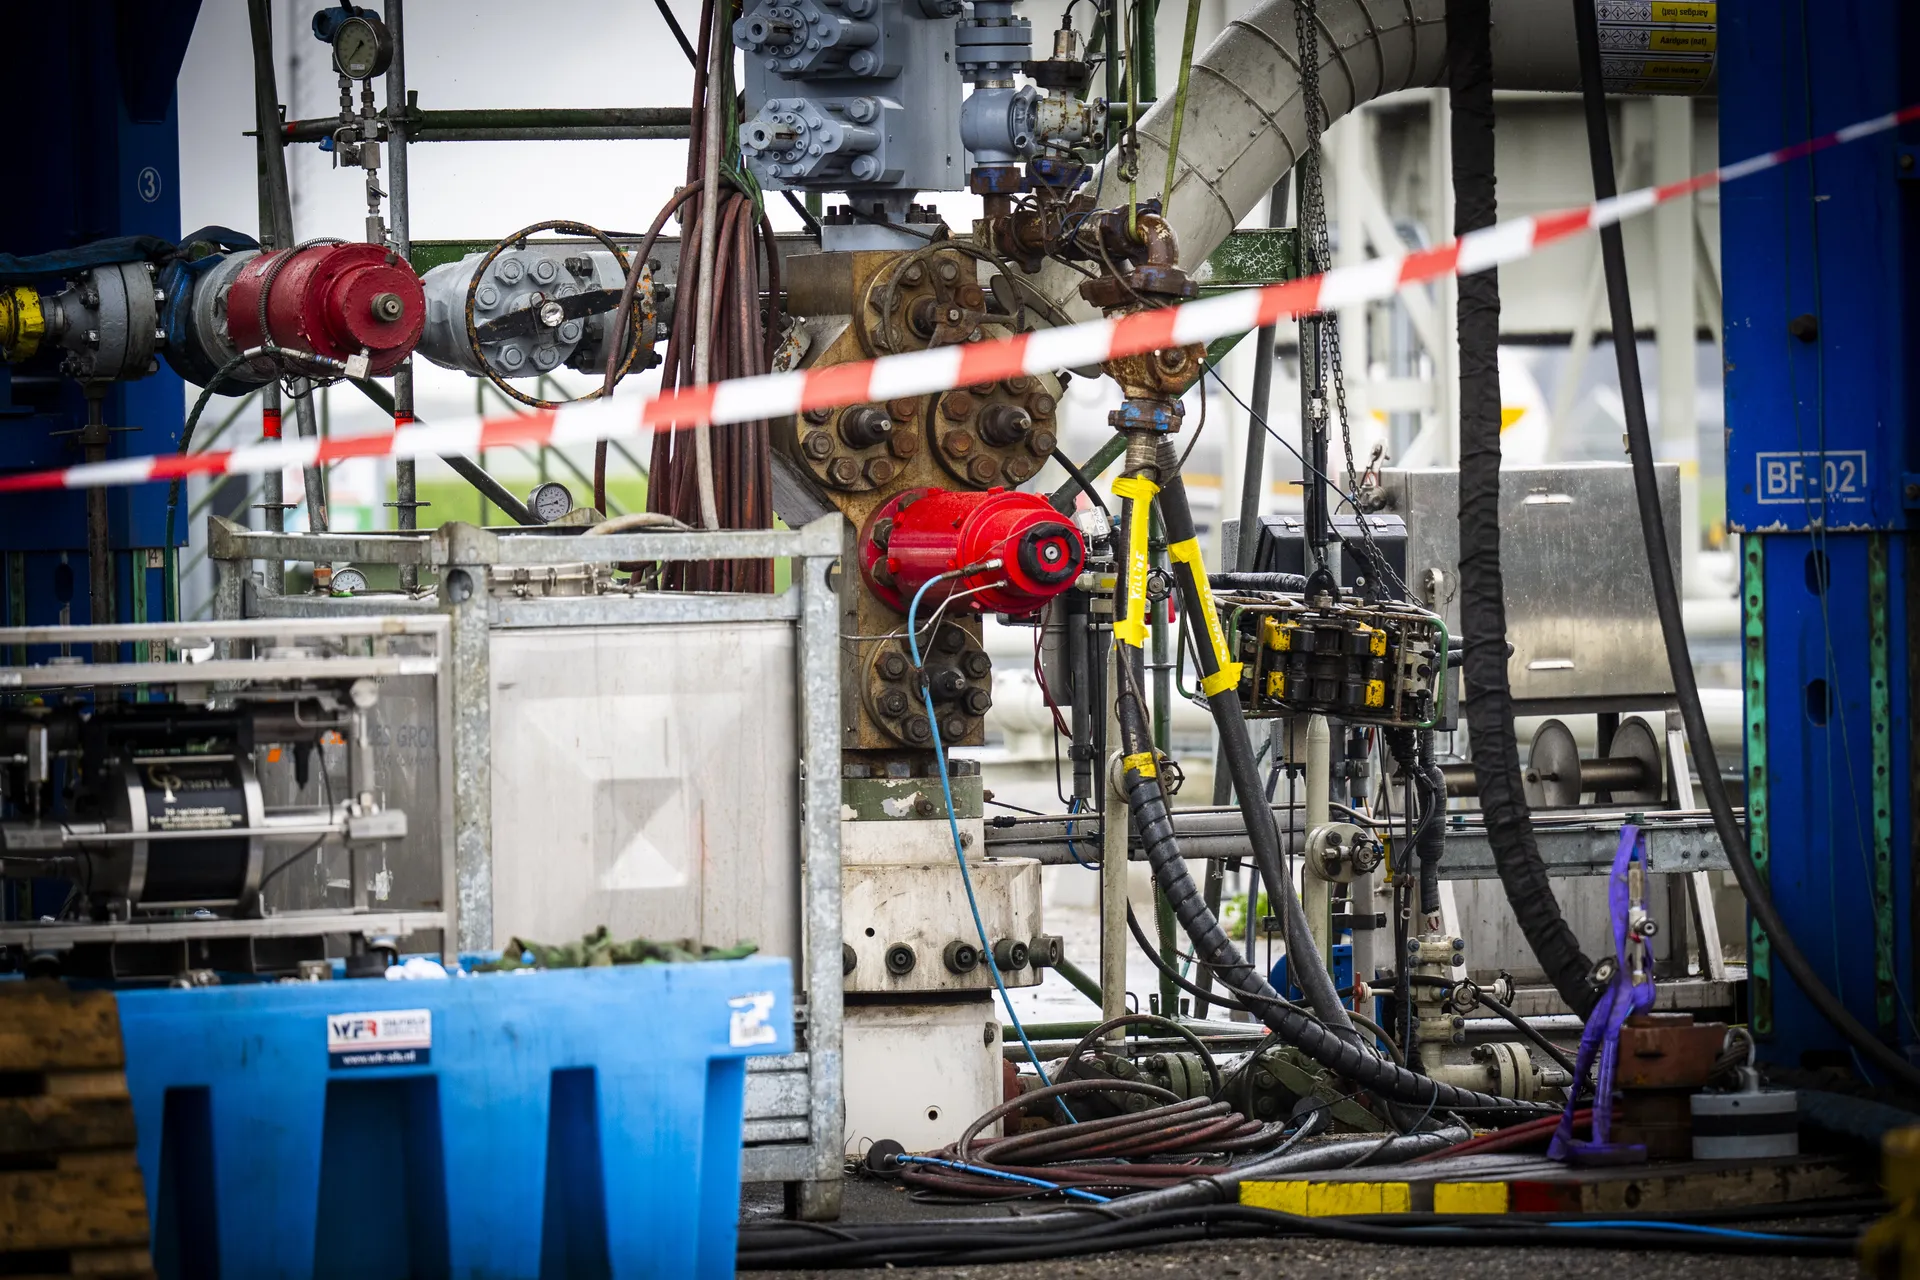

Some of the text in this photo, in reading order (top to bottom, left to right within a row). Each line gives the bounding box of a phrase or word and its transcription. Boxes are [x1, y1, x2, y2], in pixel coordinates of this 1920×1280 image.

[1661, 7, 1708, 18] Aardgas (nat)
[1660, 36, 1707, 46] Aardgas (nat)
[144, 171, 155, 198] 3
[1767, 460, 1855, 494] BF-02
